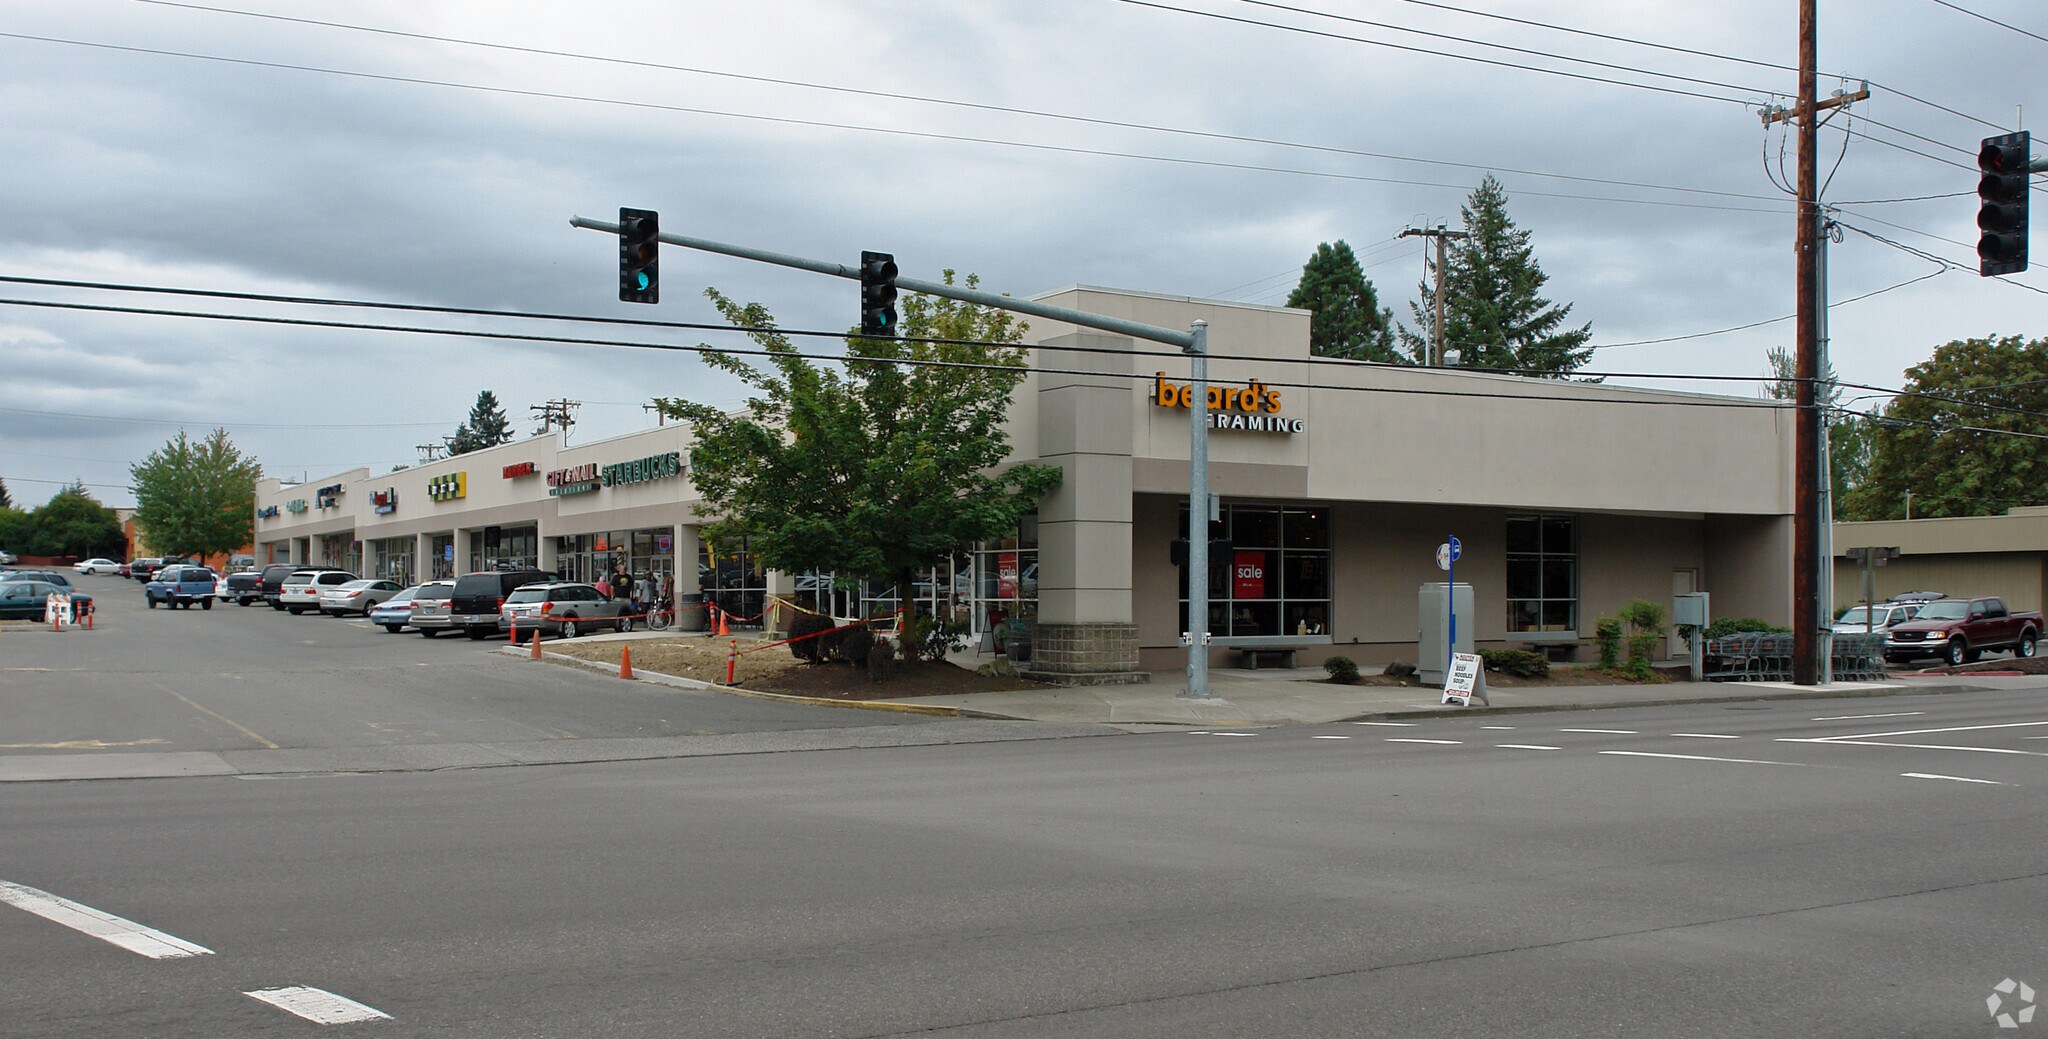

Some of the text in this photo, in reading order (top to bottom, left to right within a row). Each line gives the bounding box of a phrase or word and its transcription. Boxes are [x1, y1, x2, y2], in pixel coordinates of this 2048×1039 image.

[1156, 371, 1281, 413] beard's
[602, 452, 679, 487] STARBUCKS
[1000, 565, 1016, 579] sale
[1238, 564, 1262, 579] sale
